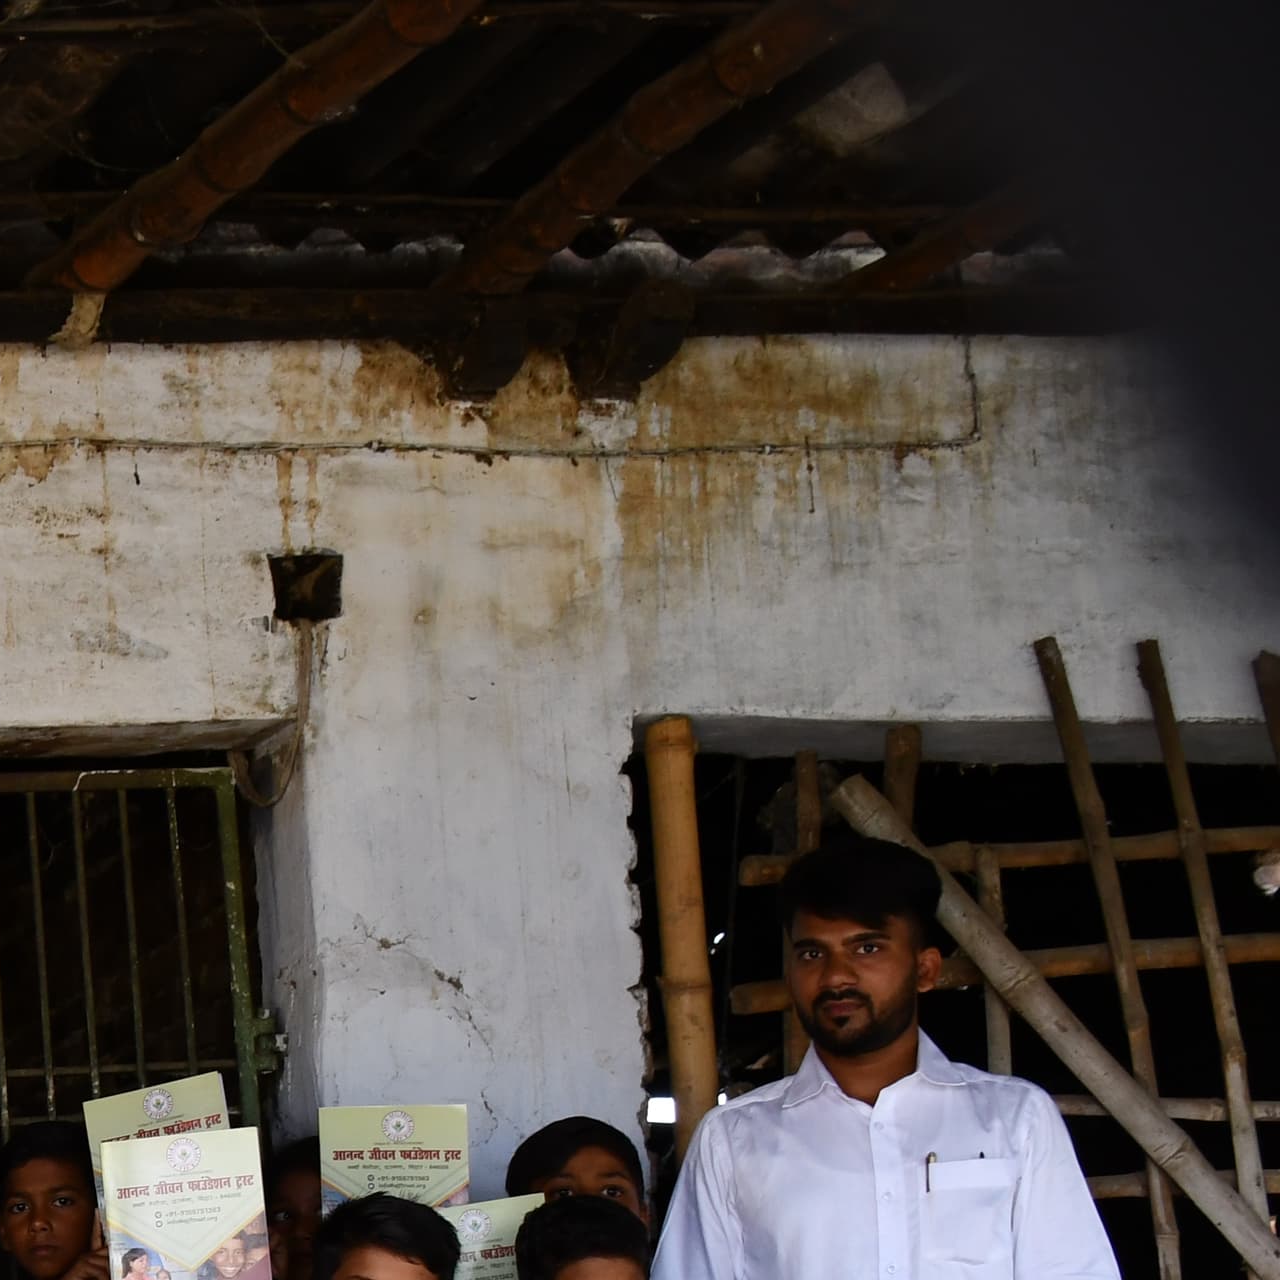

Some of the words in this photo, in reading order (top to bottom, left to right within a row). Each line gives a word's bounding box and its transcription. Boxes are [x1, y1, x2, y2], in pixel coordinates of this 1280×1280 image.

[333, 1150, 365, 1161] आनन्द
[367, 1147, 396, 1161] जीवन
[398, 1146, 441, 1161] फाउंडेशन
[443, 1149, 462, 1162] ट्रस्ट
[116, 1185, 150, 1200] आनन्द
[152, 1180, 184, 1195] जीवन
[186, 1175, 232, 1192] फाउंडेशन
[234, 1174, 255, 1190] ट्रस्ट
